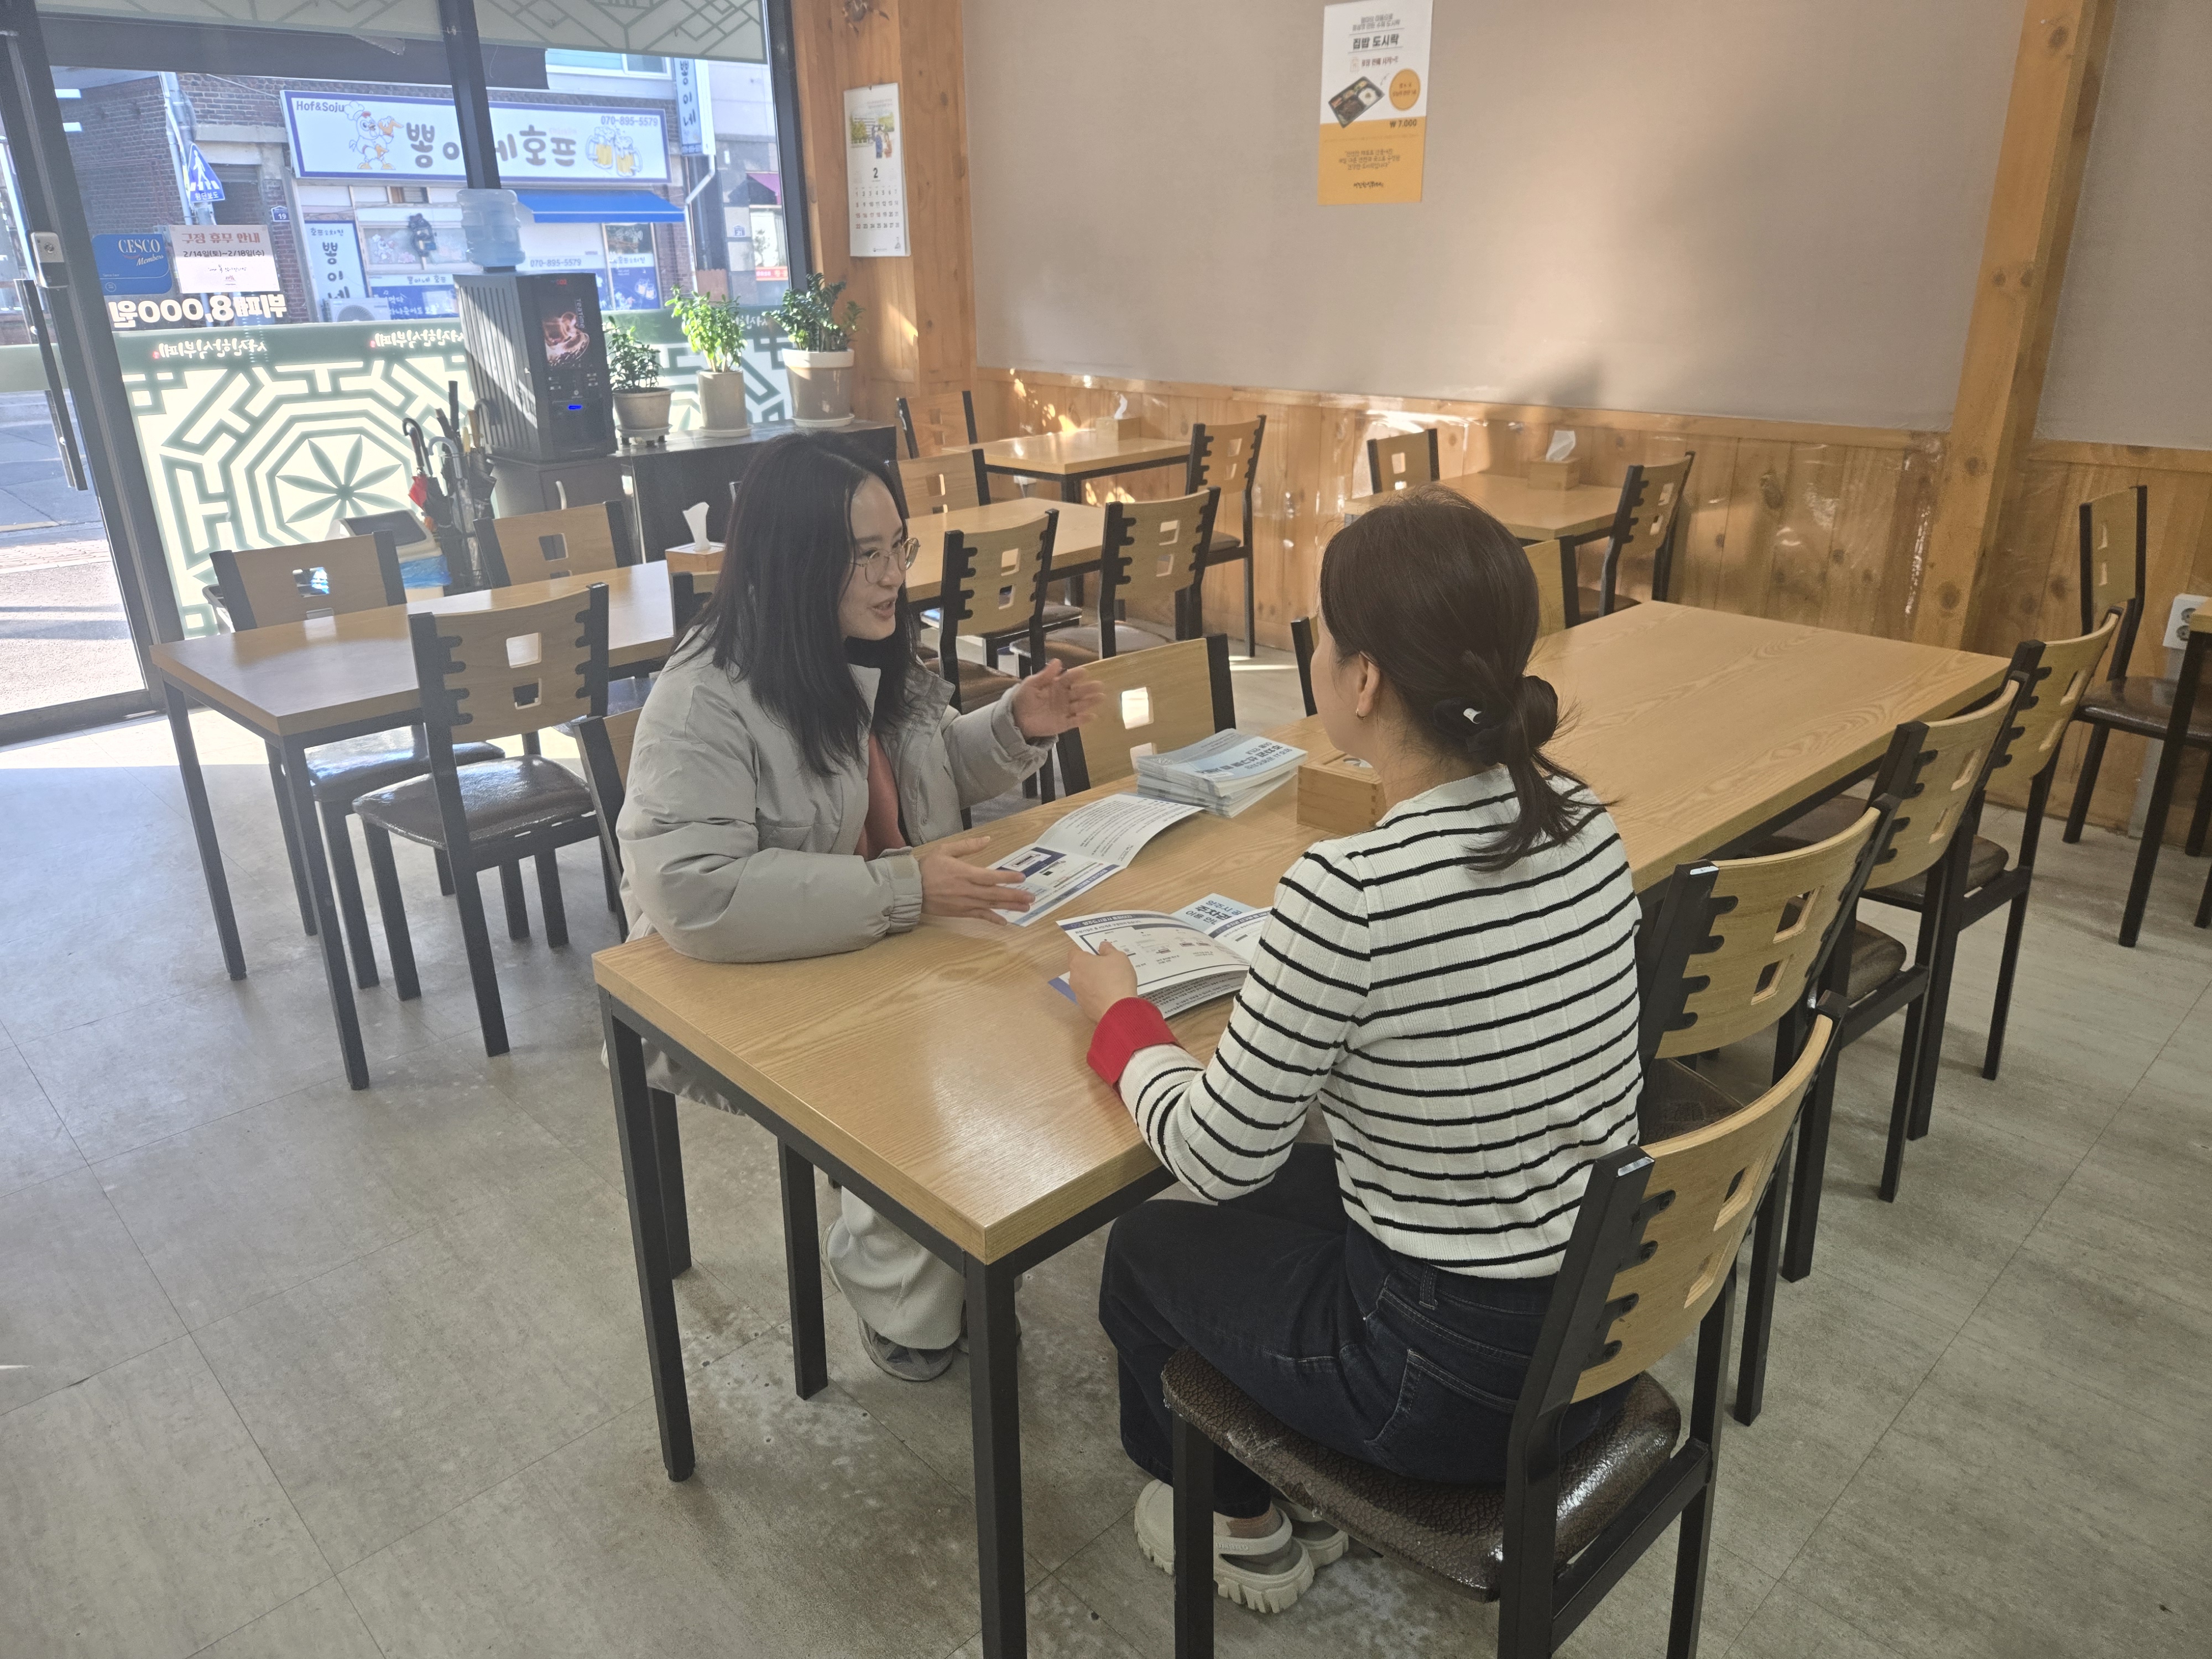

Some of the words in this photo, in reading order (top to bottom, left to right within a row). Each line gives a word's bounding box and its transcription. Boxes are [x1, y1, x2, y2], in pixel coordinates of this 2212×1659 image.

[1353, 37, 1370, 49] 집밥
[1372, 34, 1399, 46] 도시락
[680, 60, 696, 126] 뽕이네
[296, 101, 344, 112] Hof&Soju
[873, 168, 878, 178] 2
[195, 191, 218, 200] 횡단보도
[182, 232, 206, 243] 구정
[210, 232, 233, 243] 휴무
[237, 232, 260, 243] 안내
[118, 238, 160, 253] CESCO
[136, 254, 164, 267] Members
[1245, 747, 1258, 755] 안내
[1259, 745, 1283, 758] 주차권
[1206, 900, 1232, 912] 양주시
[1186, 911, 1204, 919] 이용
[1195, 905, 1232, 920] 주차권
